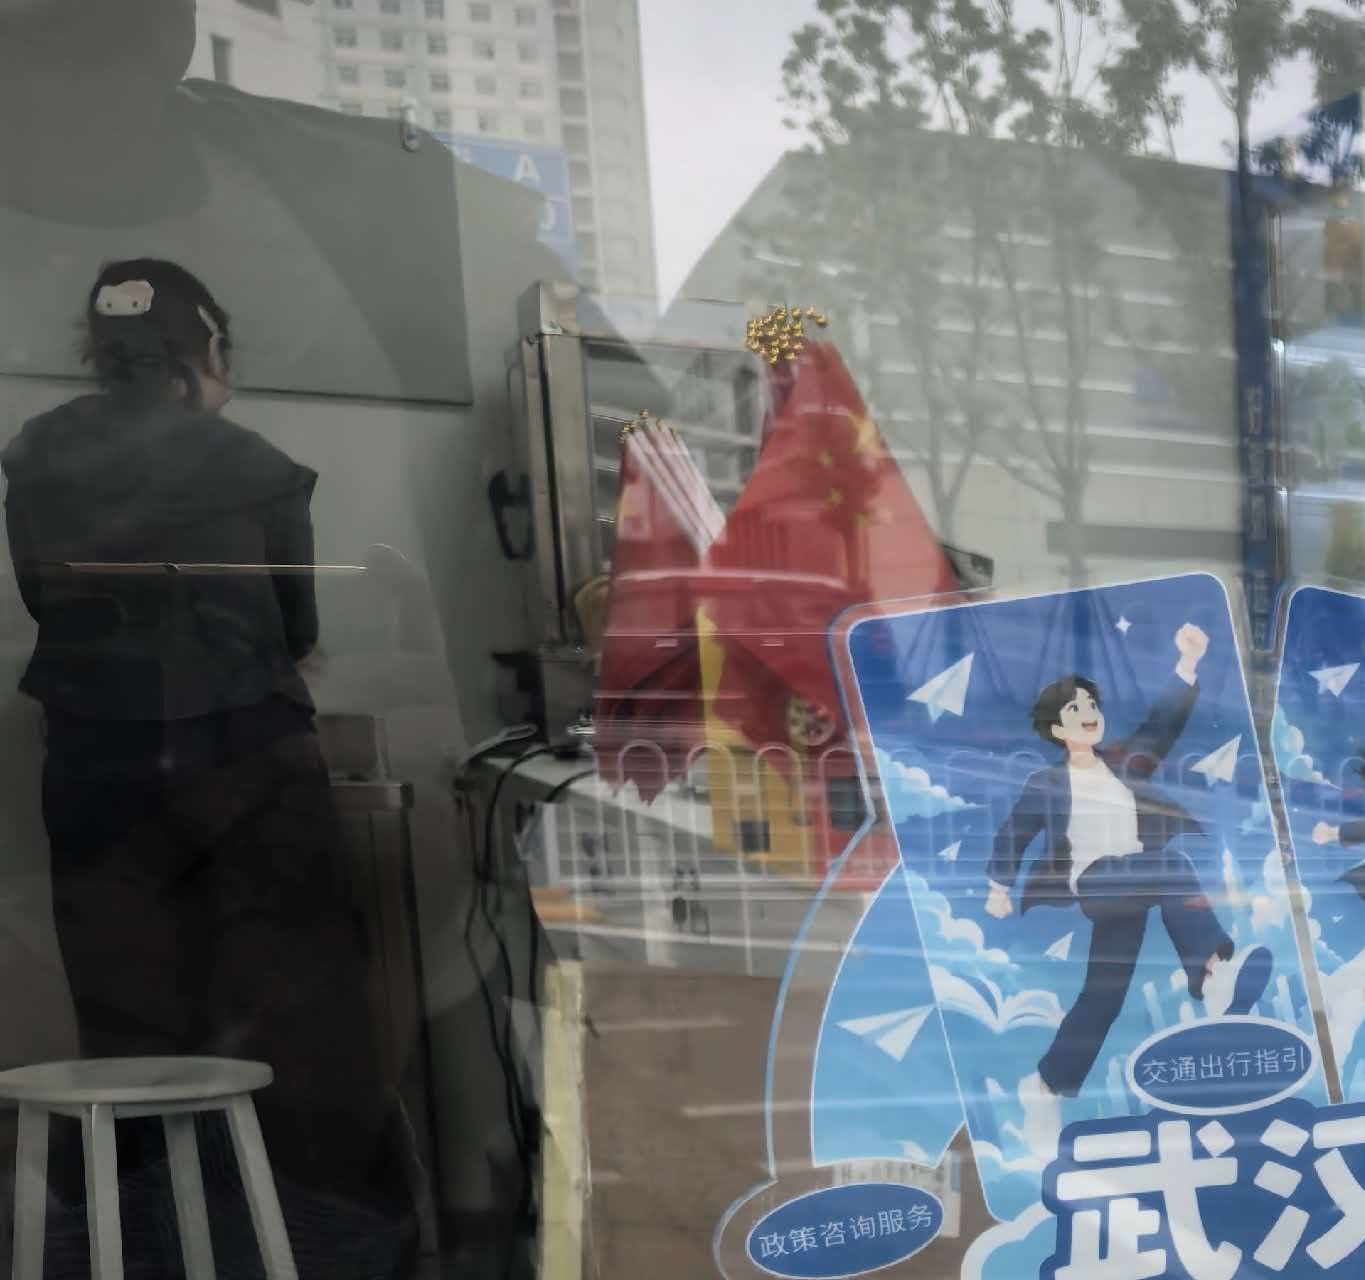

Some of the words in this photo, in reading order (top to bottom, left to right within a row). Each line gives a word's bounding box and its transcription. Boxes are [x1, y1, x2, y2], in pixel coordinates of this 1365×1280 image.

[1143, 1045, 1305, 1086] 交通出行指引
[757, 1203, 934, 1258] 政策咨询服务
